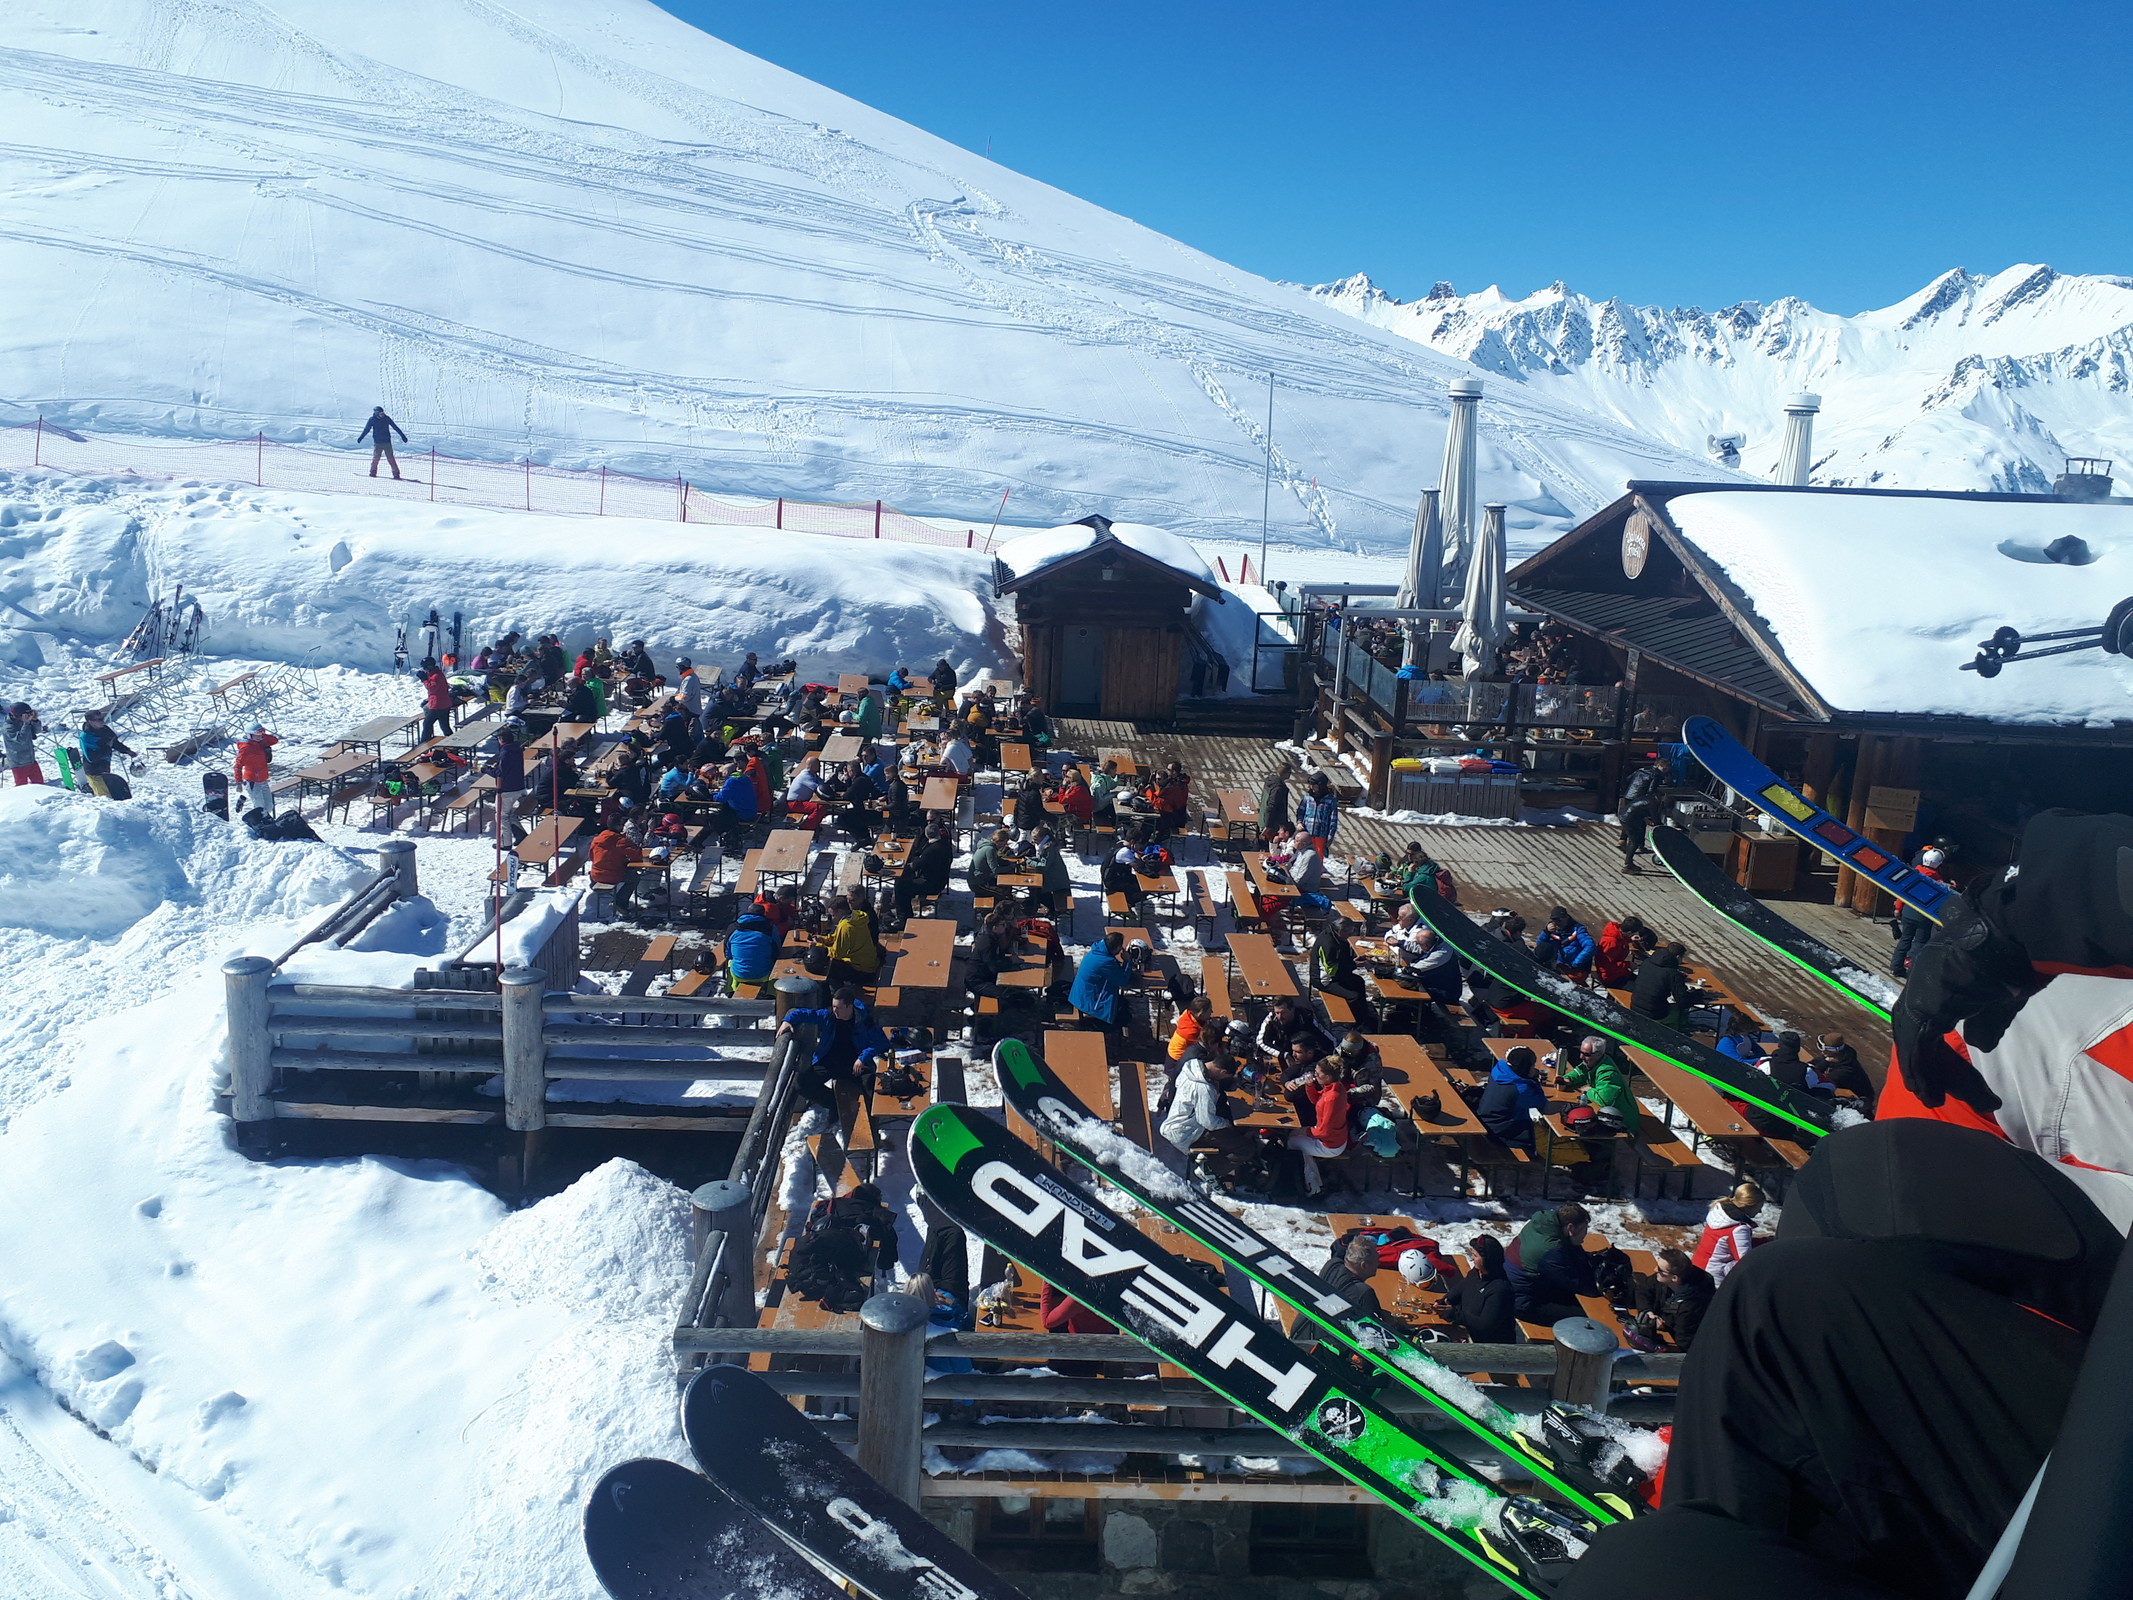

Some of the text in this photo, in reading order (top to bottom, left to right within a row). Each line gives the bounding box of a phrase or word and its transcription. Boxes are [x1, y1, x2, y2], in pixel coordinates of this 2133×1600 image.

[972, 1160, 1317, 1412] HEAD
[1036, 1096, 1353, 1319] HE
[1544, 1417, 1583, 1446] PRX
